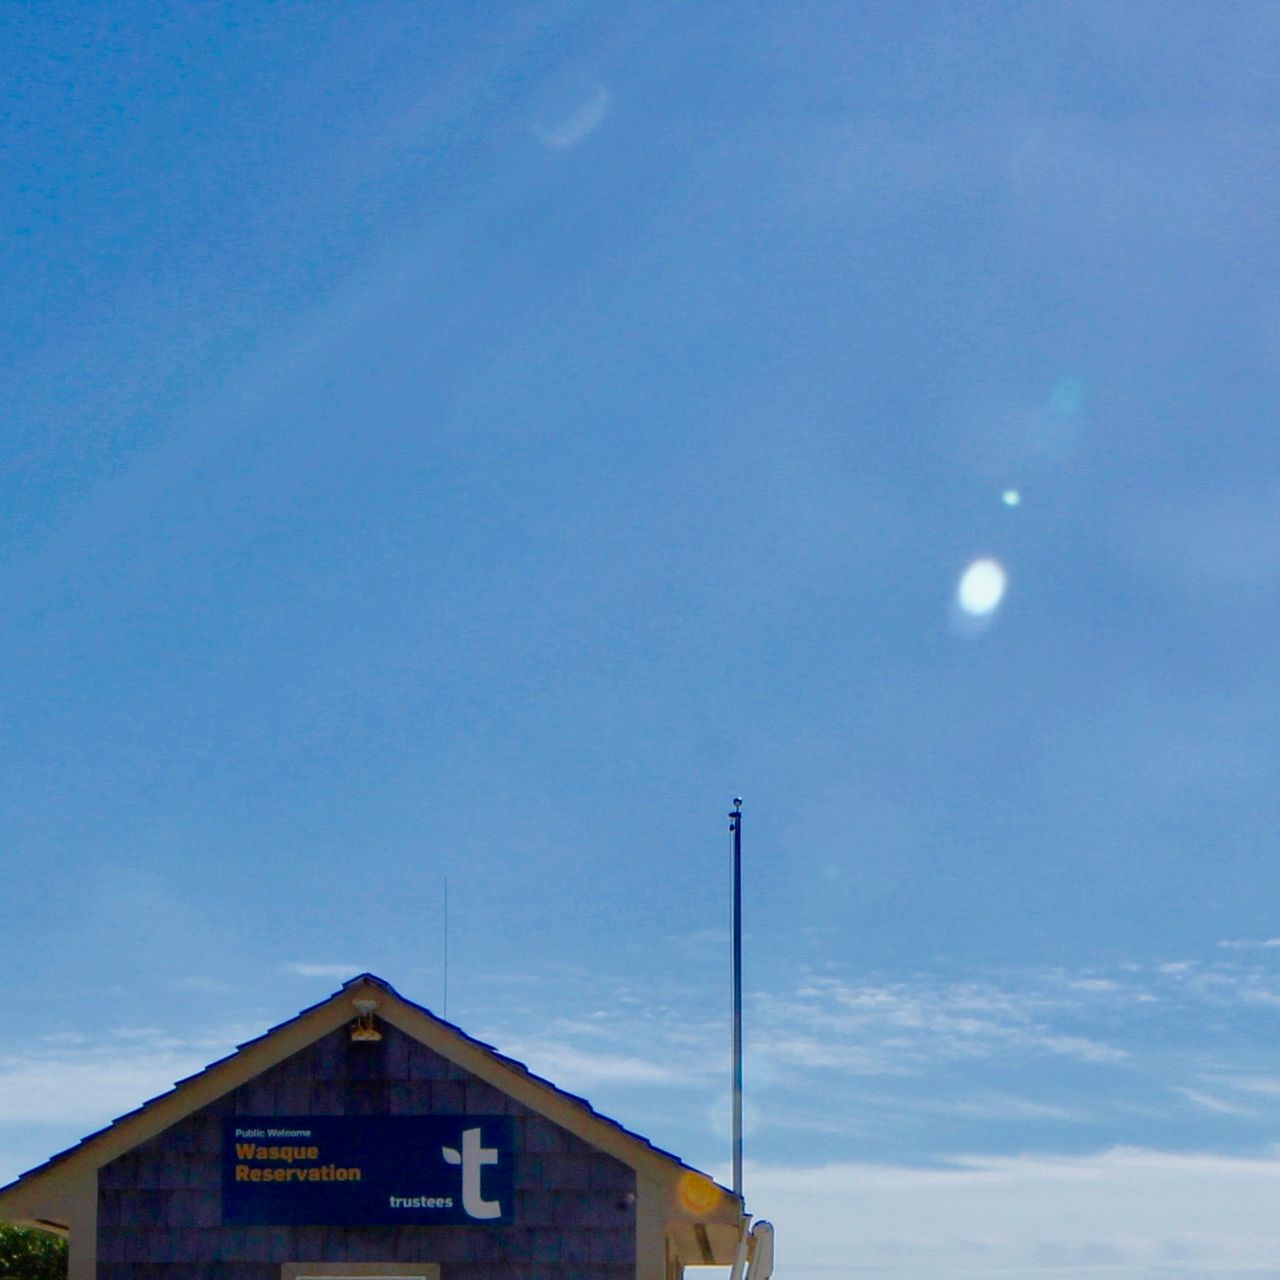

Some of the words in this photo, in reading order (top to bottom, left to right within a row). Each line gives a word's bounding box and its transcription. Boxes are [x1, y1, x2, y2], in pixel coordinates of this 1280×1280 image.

[235, 1128, 265, 1138] Public
[267, 1128, 311, 1138] Welcome
[235, 1143, 318, 1162] Wasque
[235, 1163, 361, 1182] Reservation
[389, 1195, 453, 1208] trustees
